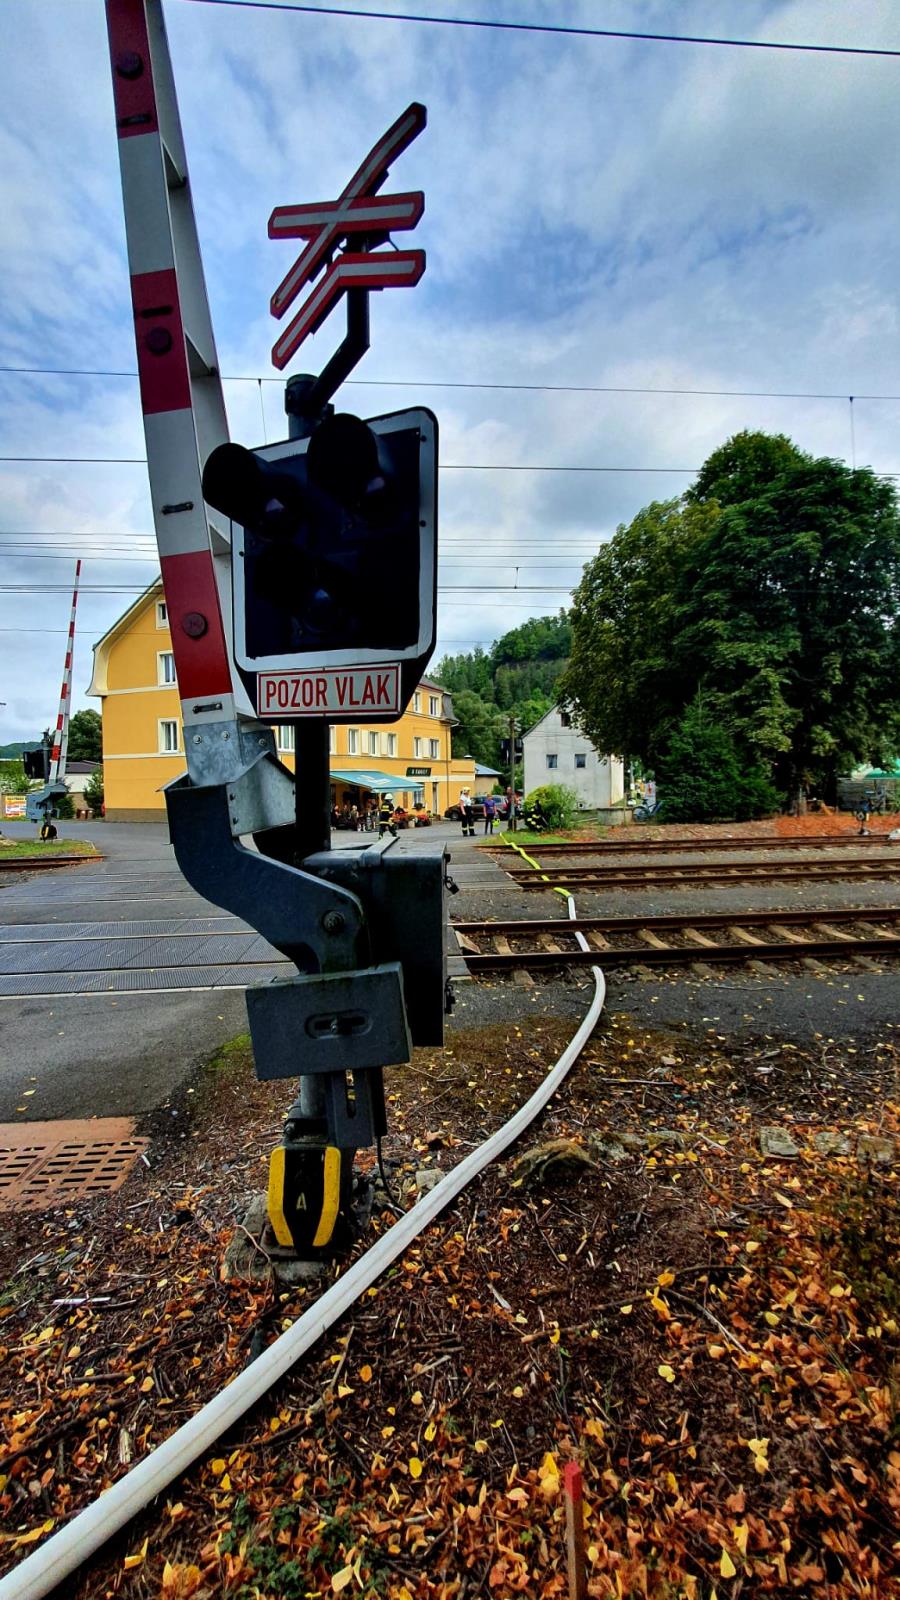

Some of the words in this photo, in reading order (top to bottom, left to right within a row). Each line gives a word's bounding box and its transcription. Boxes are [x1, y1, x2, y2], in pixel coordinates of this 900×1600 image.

[266, 678, 328, 708] POZOR
[335, 674, 391, 705] VLAK
[296, 1192, 307, 1211] A
